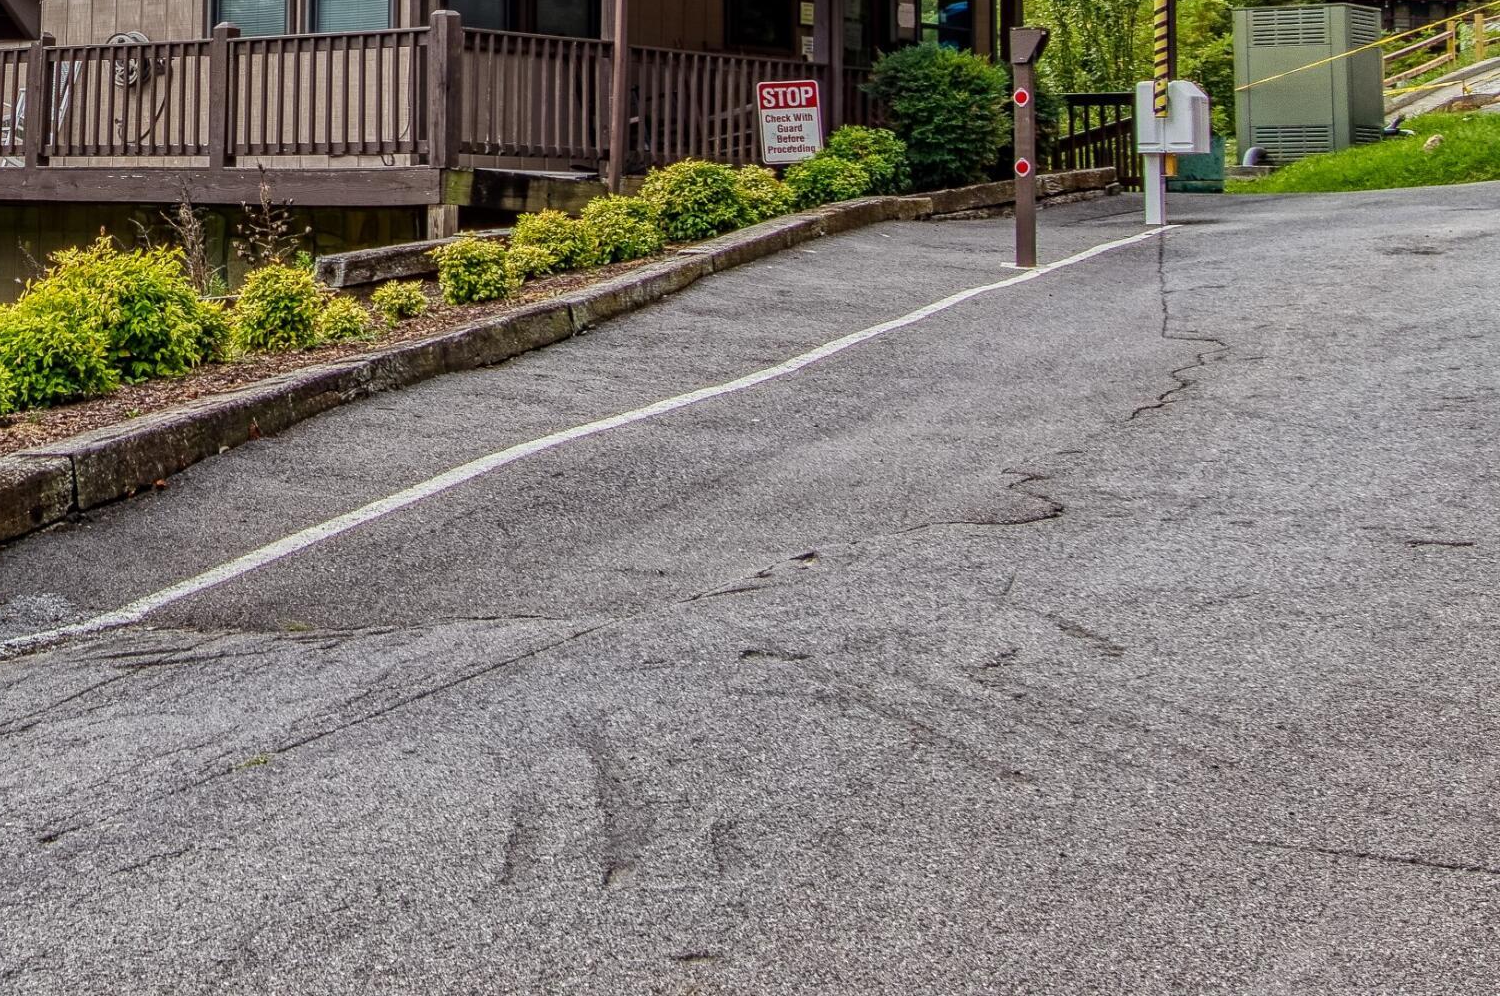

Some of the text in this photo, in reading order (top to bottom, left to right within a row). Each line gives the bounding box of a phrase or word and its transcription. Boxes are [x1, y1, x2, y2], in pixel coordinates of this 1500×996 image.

[762, 86, 813, 107] STOP
[765, 113, 813, 123] Check With
[777, 124, 803, 133] Guard
[777, 134, 805, 143] Before
[767, 145, 816, 154] Proceeding
